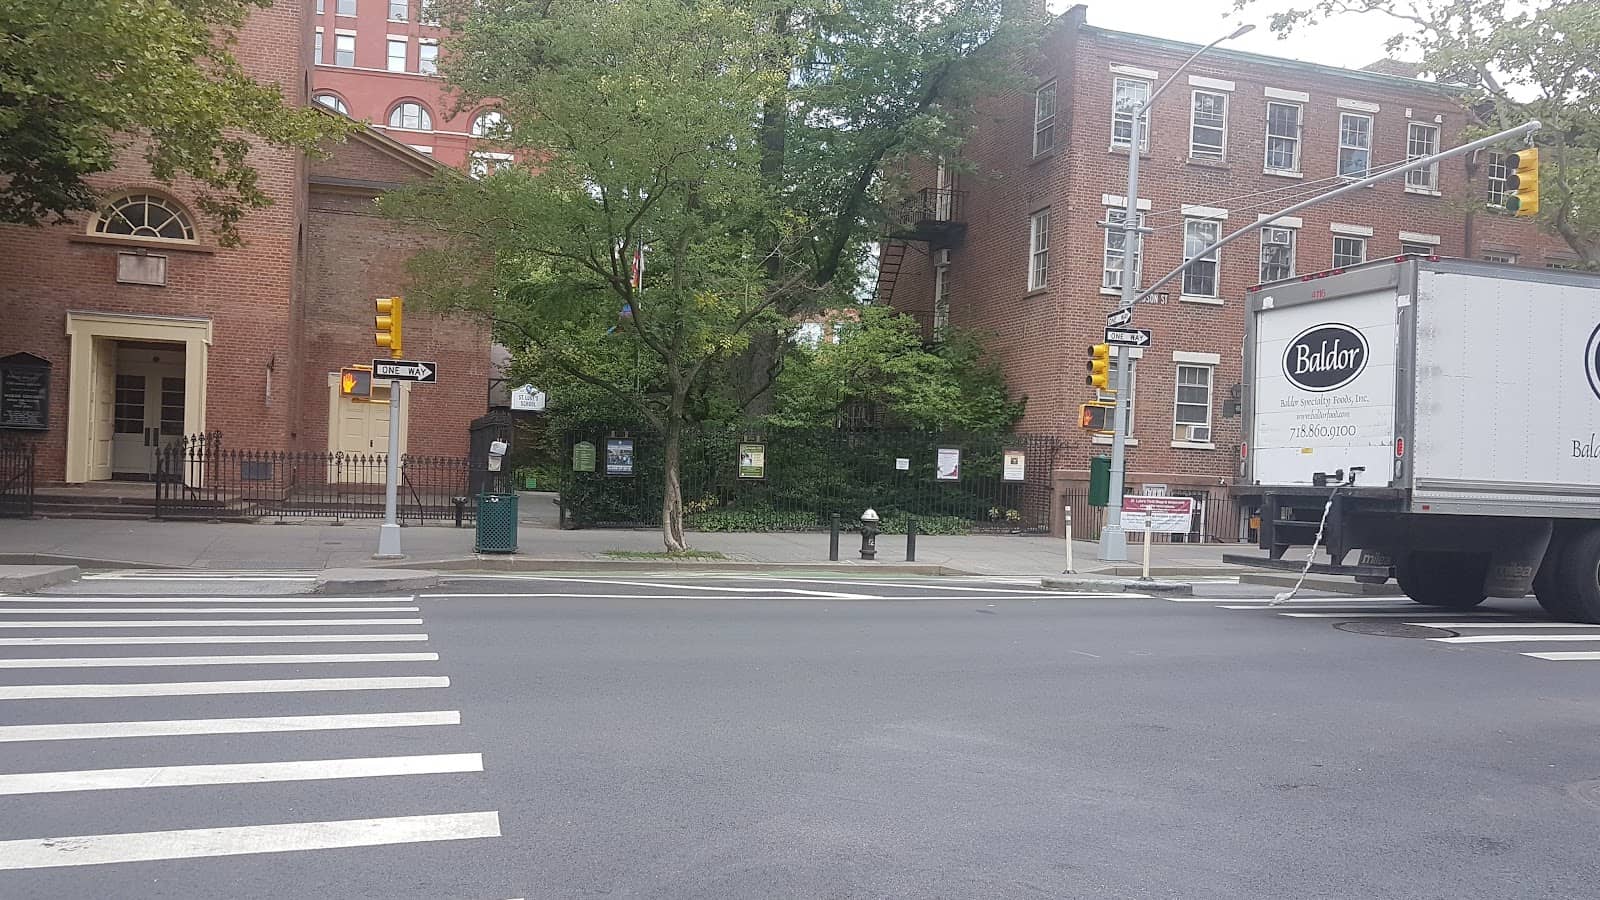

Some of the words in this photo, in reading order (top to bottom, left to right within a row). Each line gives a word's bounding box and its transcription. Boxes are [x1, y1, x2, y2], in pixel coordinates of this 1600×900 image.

[1161, 294, 1168, 304] ST
[1110, 332, 1124, 340] ONE
[1130, 334, 1144, 342] WAY
[1294, 339, 1360, 374] Baldor
[382, 366, 400, 375] ONE
[408, 367, 426, 376] WAY
[1280, 395, 1299, 408] Baldor
[1300, 393, 1331, 408] Specialty
[1333, 394, 1354, 406] Foods,
[1355, 393, 1370, 403] Inc.
[1290, 424, 1357, 440] 718.860.9100
